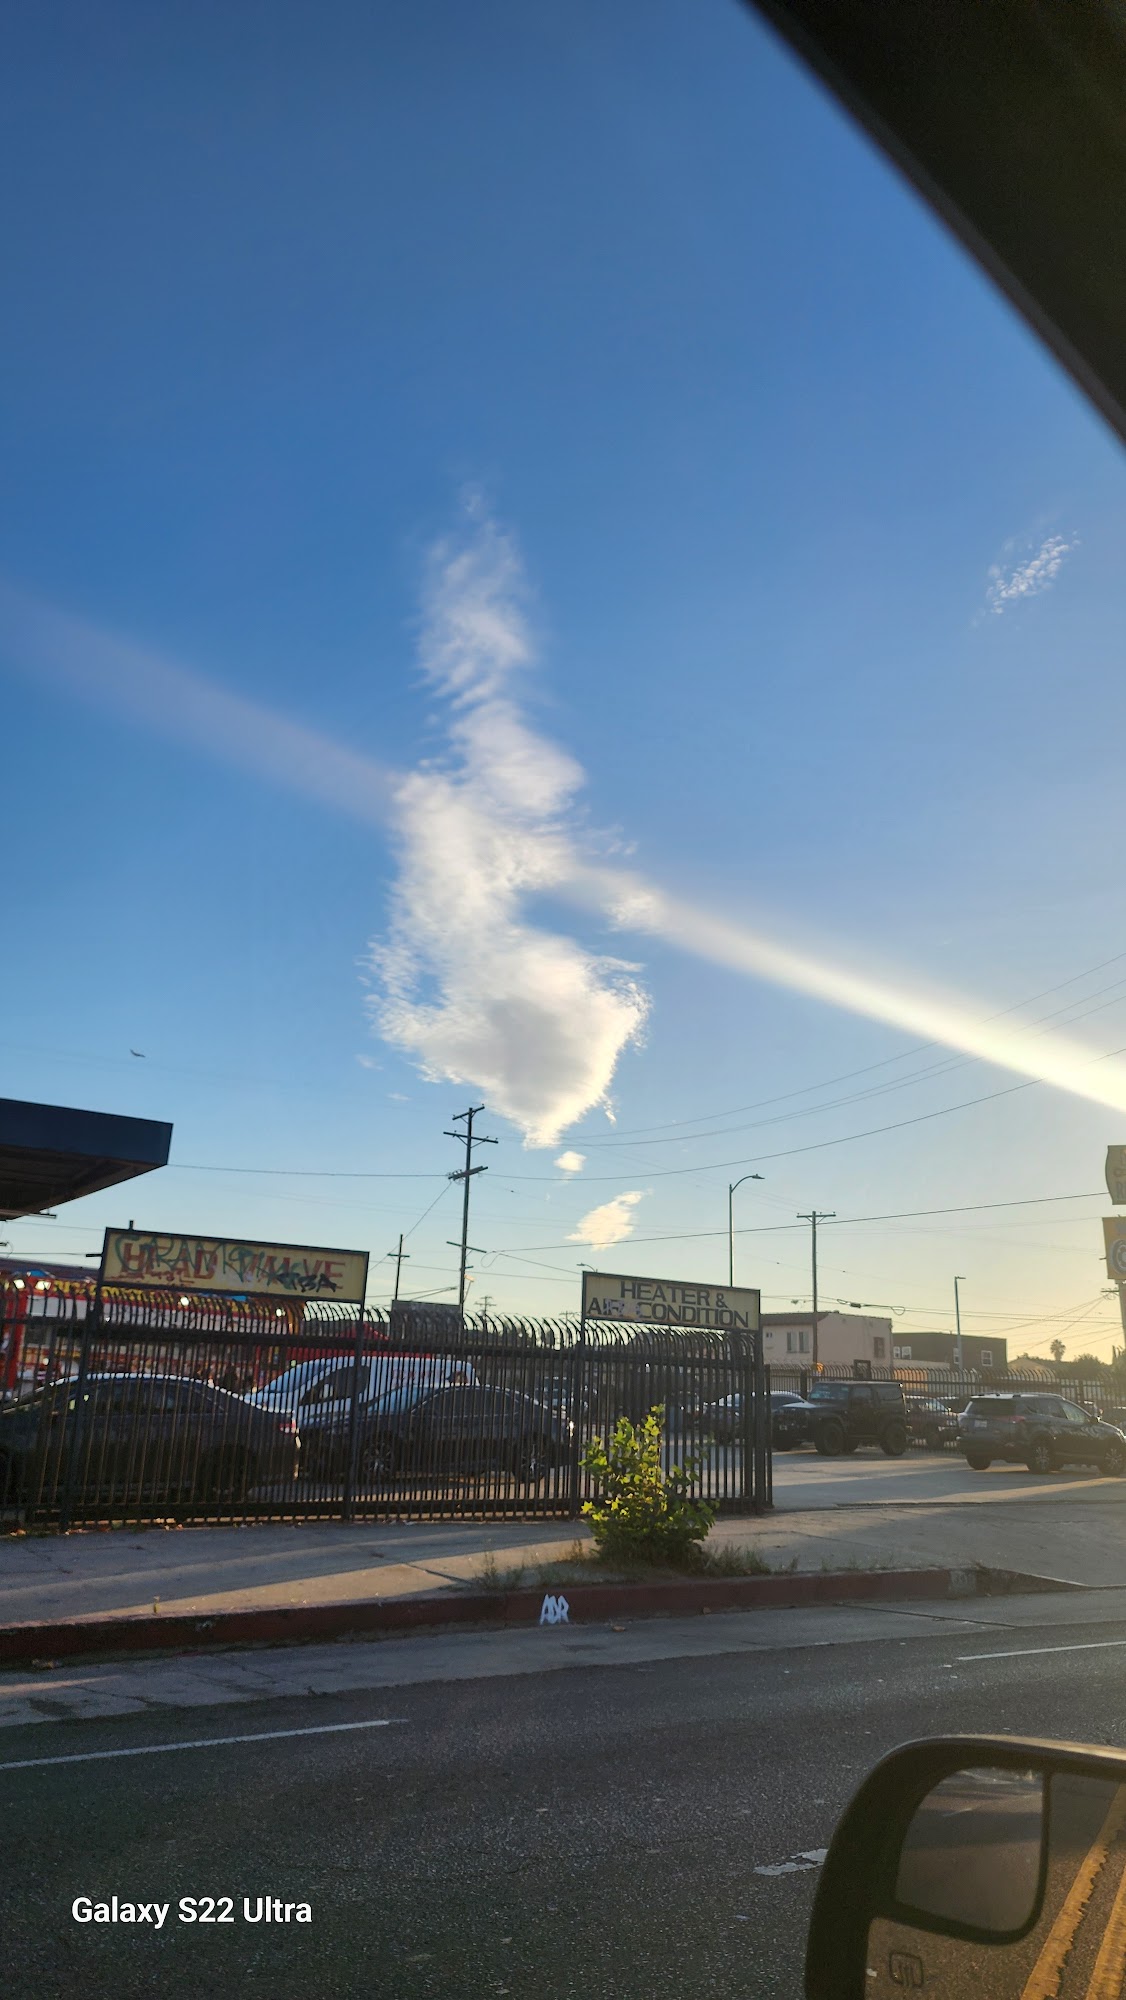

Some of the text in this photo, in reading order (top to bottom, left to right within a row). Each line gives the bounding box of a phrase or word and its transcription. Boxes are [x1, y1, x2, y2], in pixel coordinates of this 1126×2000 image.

[620, 1280, 729, 1309] HEATER &
[636, 1300, 749, 1328] CONDITION
